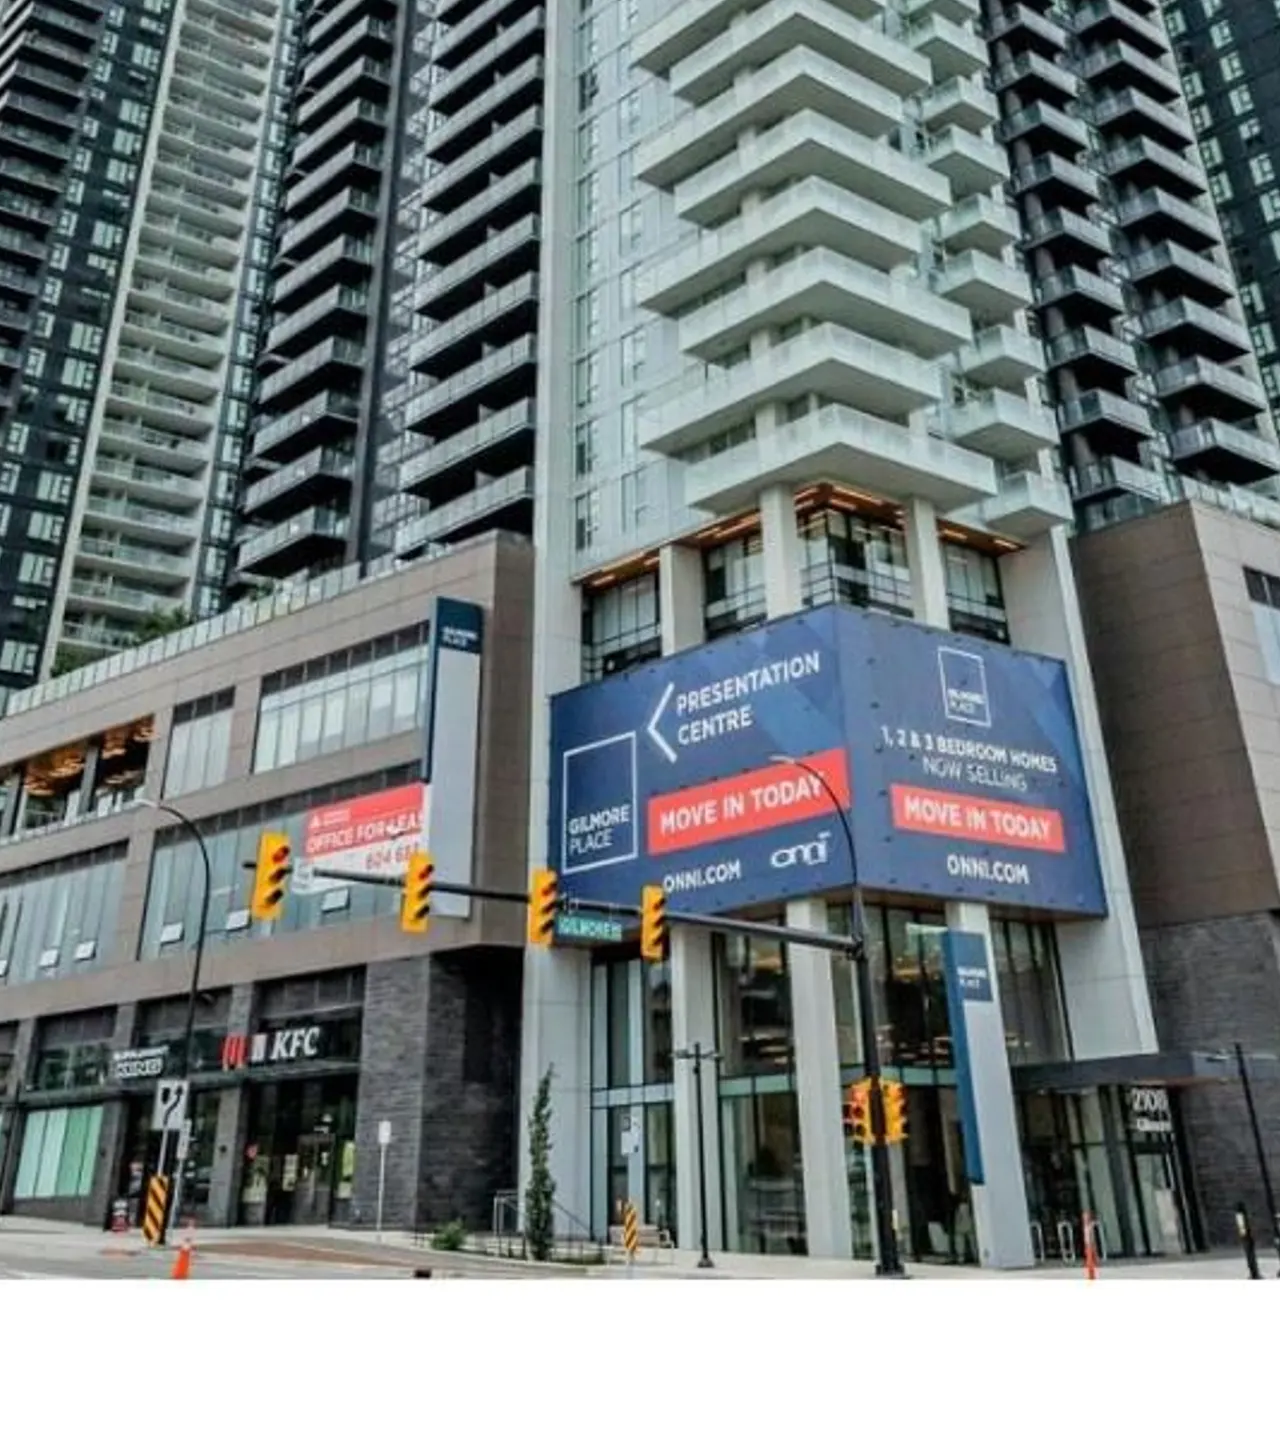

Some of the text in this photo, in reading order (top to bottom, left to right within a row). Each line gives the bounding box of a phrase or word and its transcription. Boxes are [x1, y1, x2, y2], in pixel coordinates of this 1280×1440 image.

[676, 650, 821, 715] PRESENTATION
[677, 705, 754, 745] CENTRE
[896, 729, 907, 748] 2
[936, 735, 1007, 765] BEDROOM
[1010, 748, 1058, 773] HOMES
[922, 757, 1028, 792] NOW SELLING
[568, 804, 631, 835] GILMORE
[659, 771, 825, 836] MOVE IN TODAY
[904, 795, 1052, 842] MOVE IN TODAY
[306, 826, 355, 854] OFFICE
[357, 820, 386, 842] FOR
[569, 828, 613, 856] PLACE
[662, 860, 742, 894] ONNI.COM
[946, 854, 1030, 886] ONNI.COM
[270, 1026, 321, 1060] KFC
